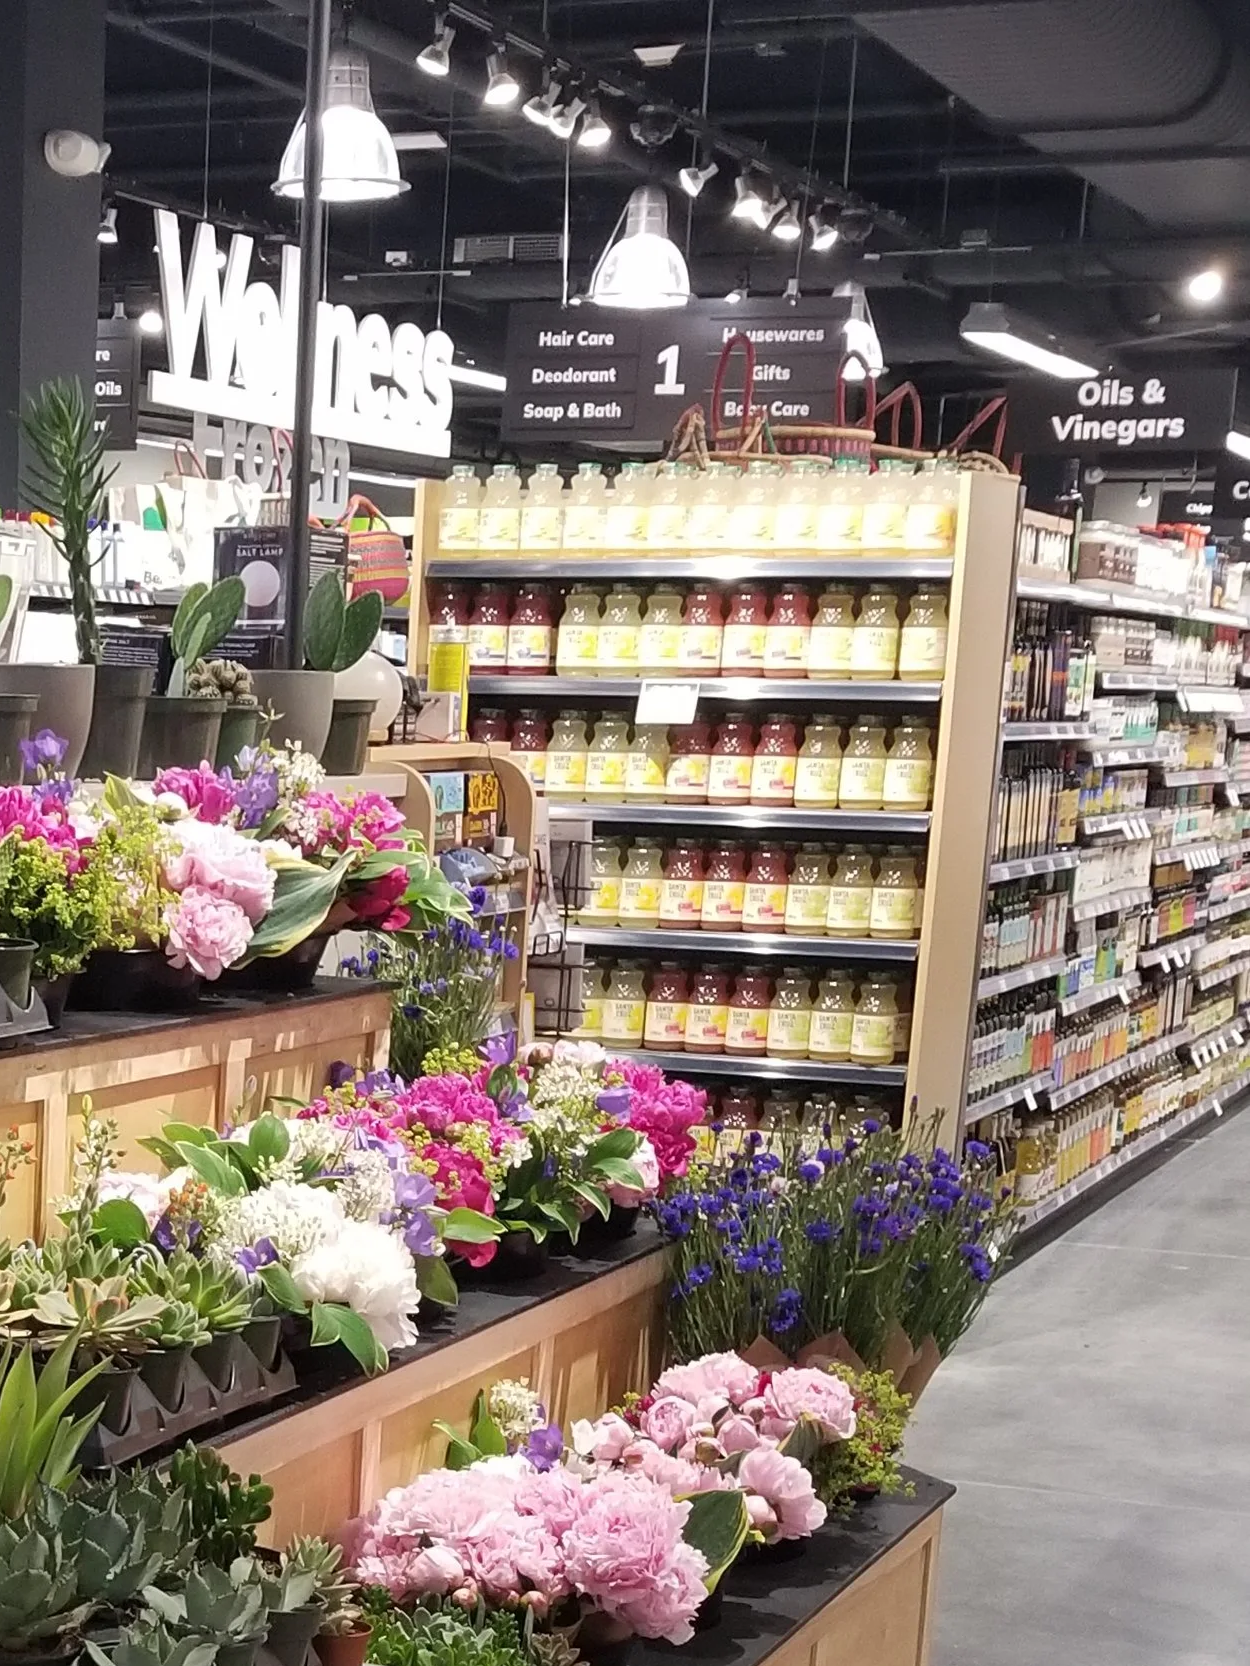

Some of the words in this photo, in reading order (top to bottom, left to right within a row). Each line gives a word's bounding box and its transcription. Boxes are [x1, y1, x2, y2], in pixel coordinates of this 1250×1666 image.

[153, 208, 455, 430] Welness
[539, 331, 573, 347] Hair
[577, 330, 614, 347] Care
[722, 327, 824, 343] Husewares
[532, 366, 616, 385] Deodorant
[654, 344, 685, 396] 1
[752, 364, 790, 382] Gifts
[1078, 379, 1134, 407] Oils
[1142, 378, 1166, 404] &
[523, 403, 564, 422] Soap
[567, 404, 579, 419] &
[583, 402, 621, 419] Bath
[771, 401, 809, 417] Care
[1051, 413, 1185, 446] Vinegars
